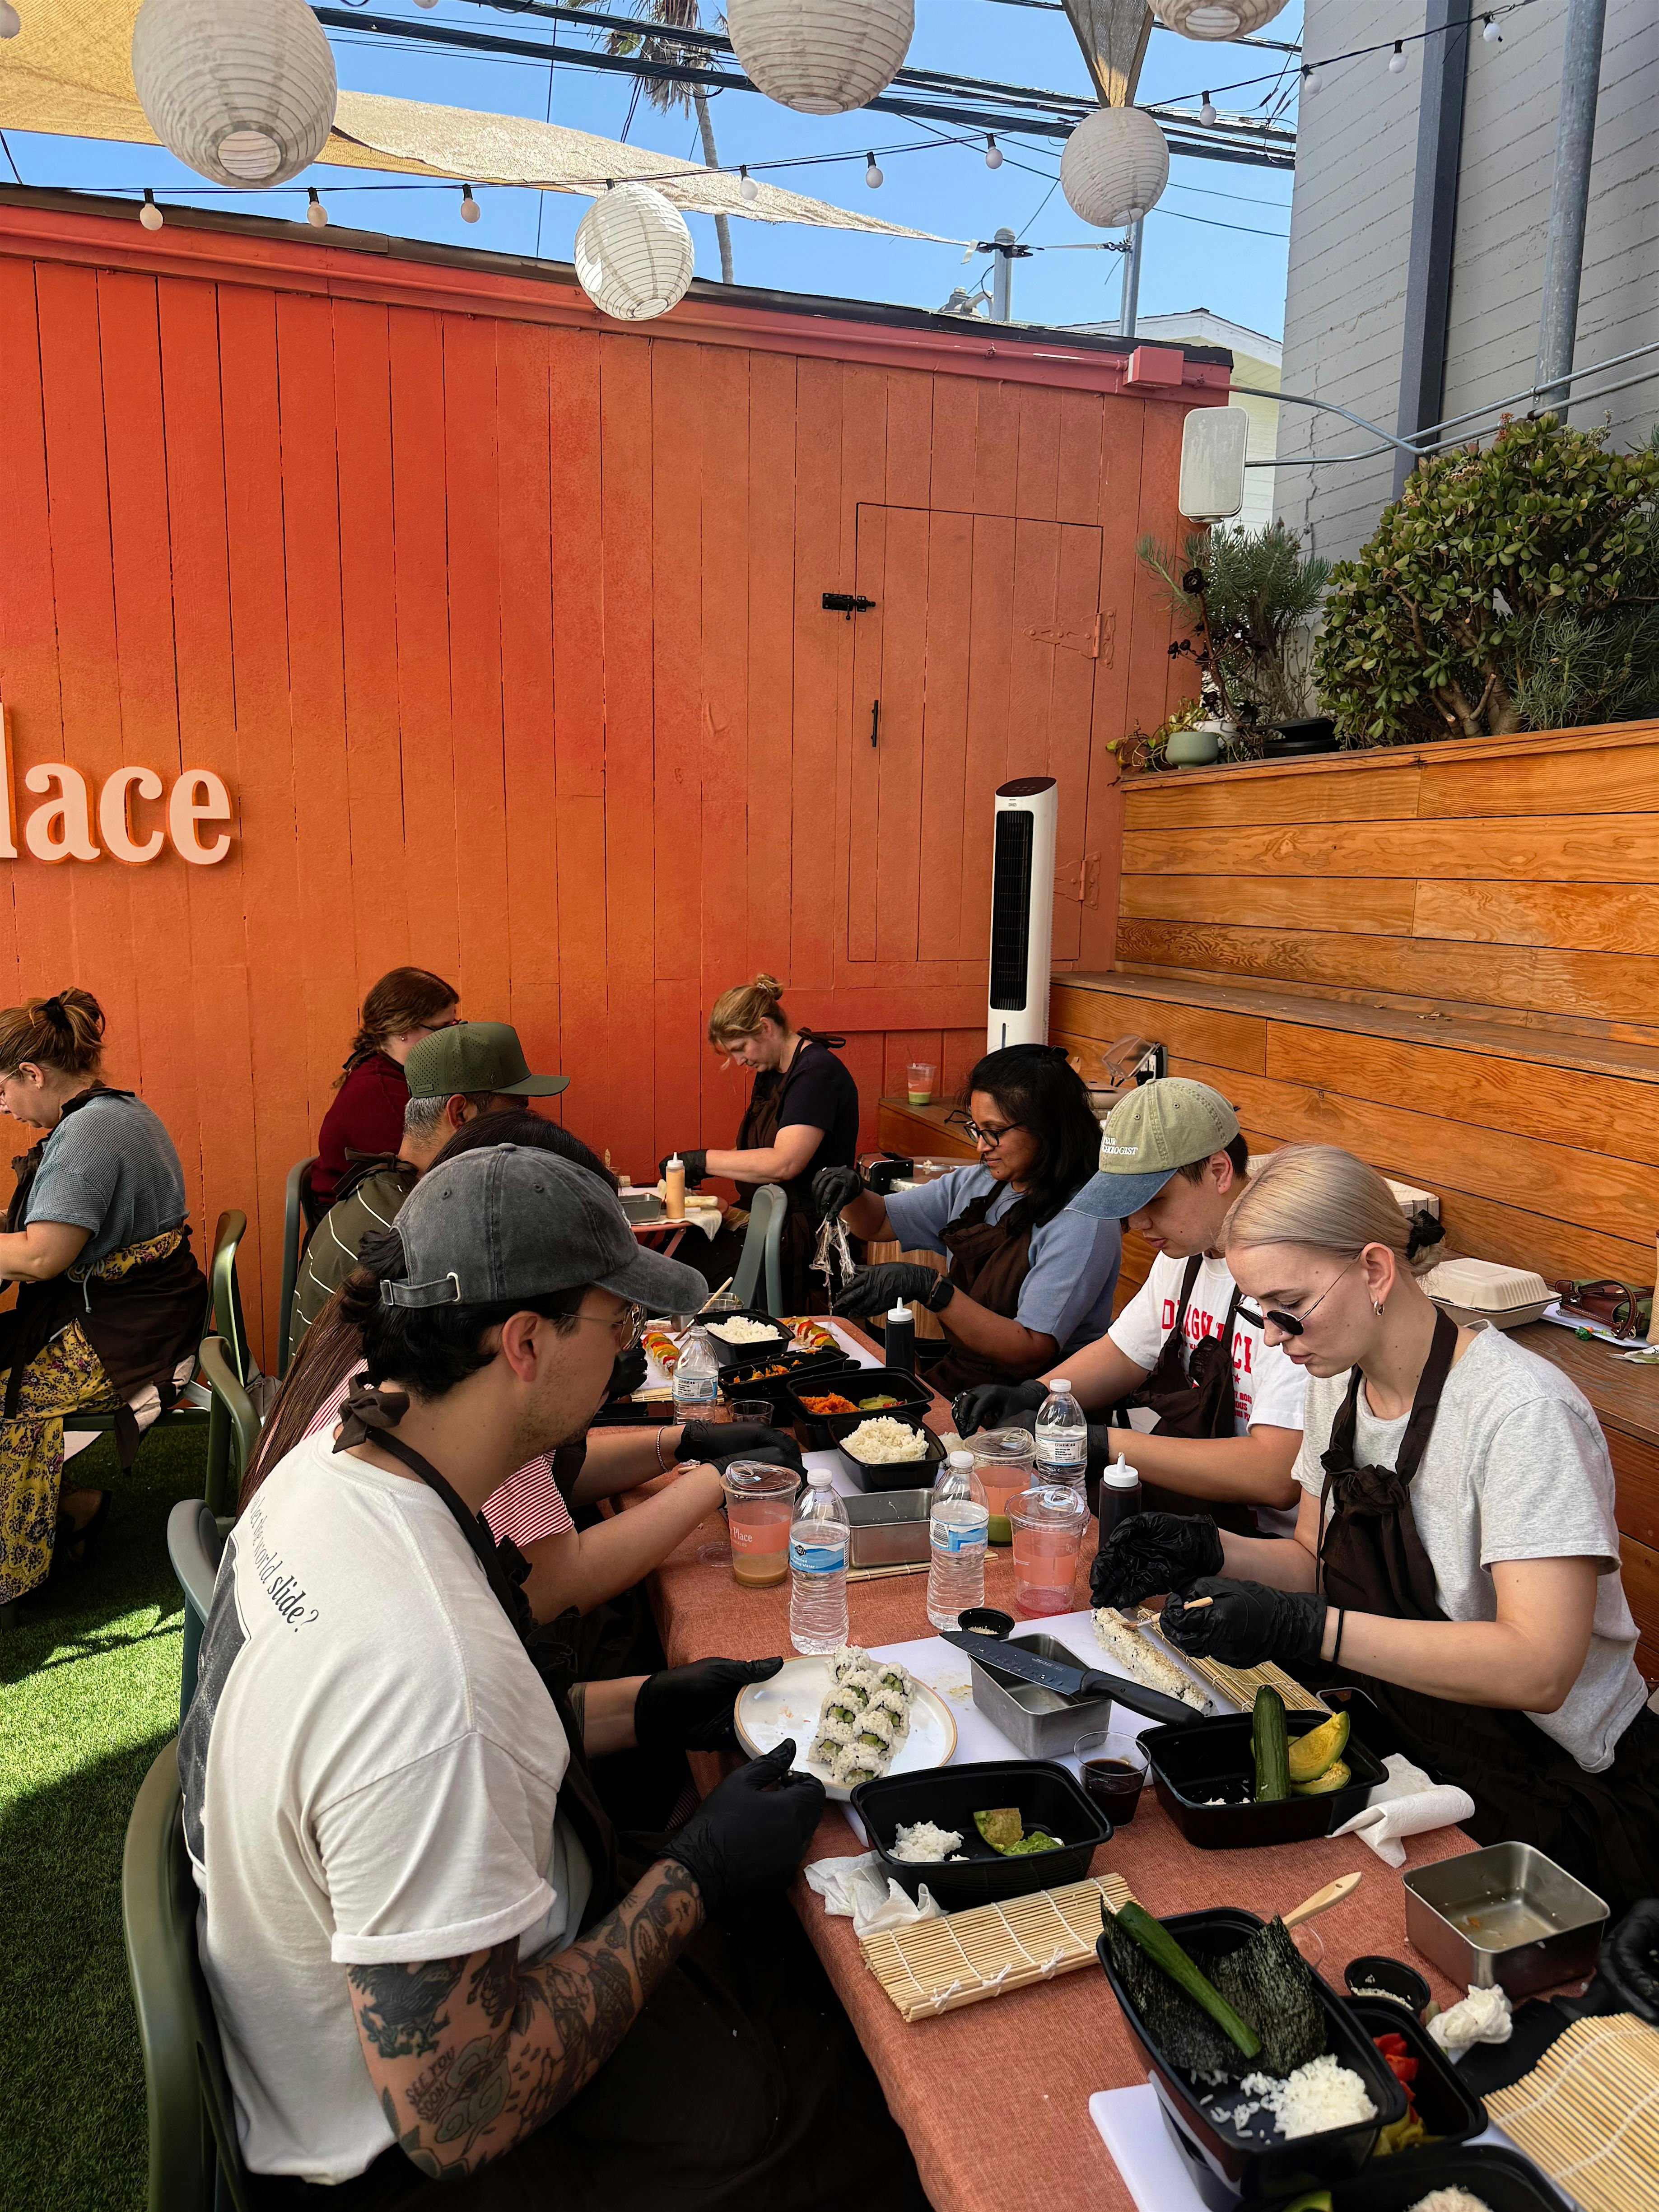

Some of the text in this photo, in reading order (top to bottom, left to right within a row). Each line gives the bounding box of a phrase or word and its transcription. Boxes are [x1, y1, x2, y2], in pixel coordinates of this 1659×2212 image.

[733, 1527, 753, 1542] Place
[254, 1537, 283, 1584] world
[267, 1575, 319, 1633] slide?
[428, 2045, 455, 2078] YOU
